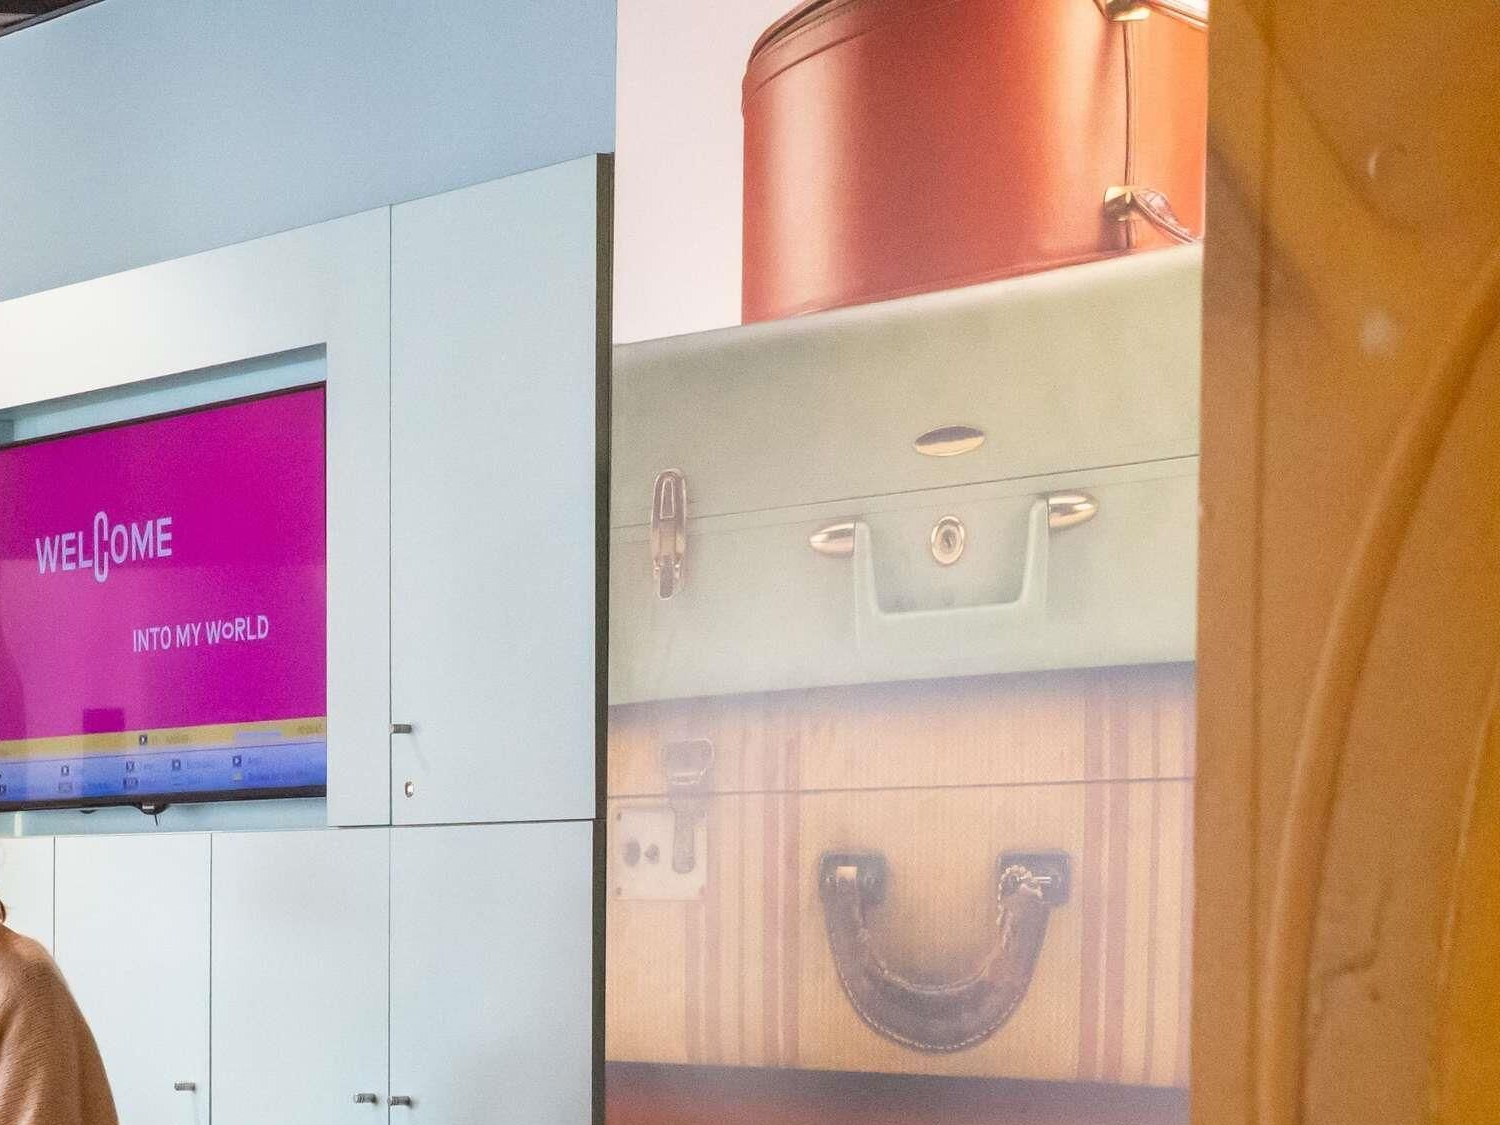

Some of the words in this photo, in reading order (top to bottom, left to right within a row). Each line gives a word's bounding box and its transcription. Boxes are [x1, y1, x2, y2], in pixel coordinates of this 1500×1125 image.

[36, 511, 172, 582] WELCOME
[133, 626, 172, 652] INTO
[176, 622, 201, 648] MY
